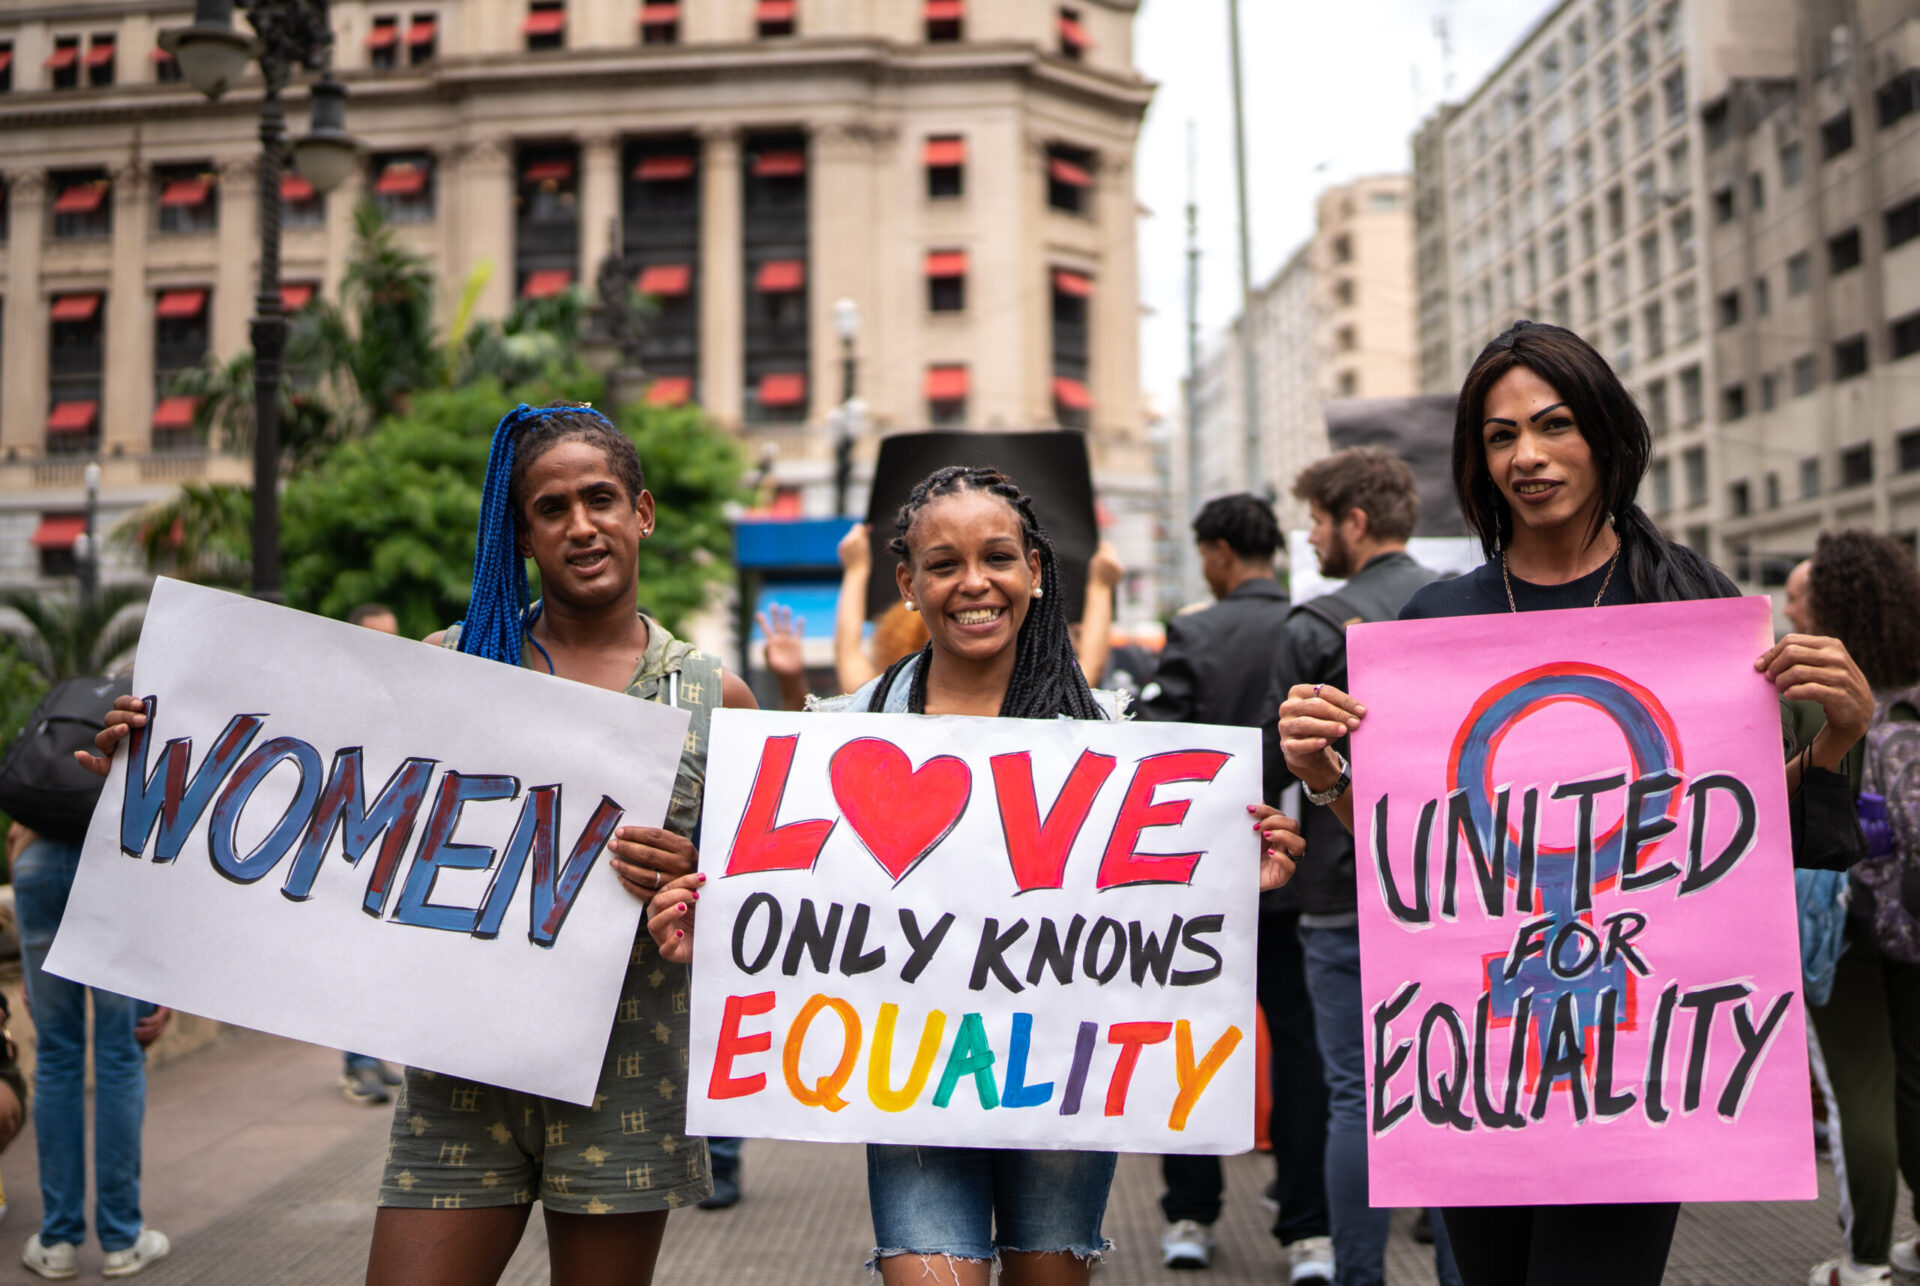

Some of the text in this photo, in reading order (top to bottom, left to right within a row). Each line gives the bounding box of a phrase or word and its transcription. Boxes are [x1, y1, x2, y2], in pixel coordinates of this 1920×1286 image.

[119, 695, 625, 948] WOMEN
[1370, 770, 1758, 930] UNITED
[731, 892, 1225, 994] ONLY KNOWS
[1502, 911, 1651, 982] FOR
[707, 991, 1243, 1132] EQUALITY
[1371, 978, 1795, 1138] EQUALITY
